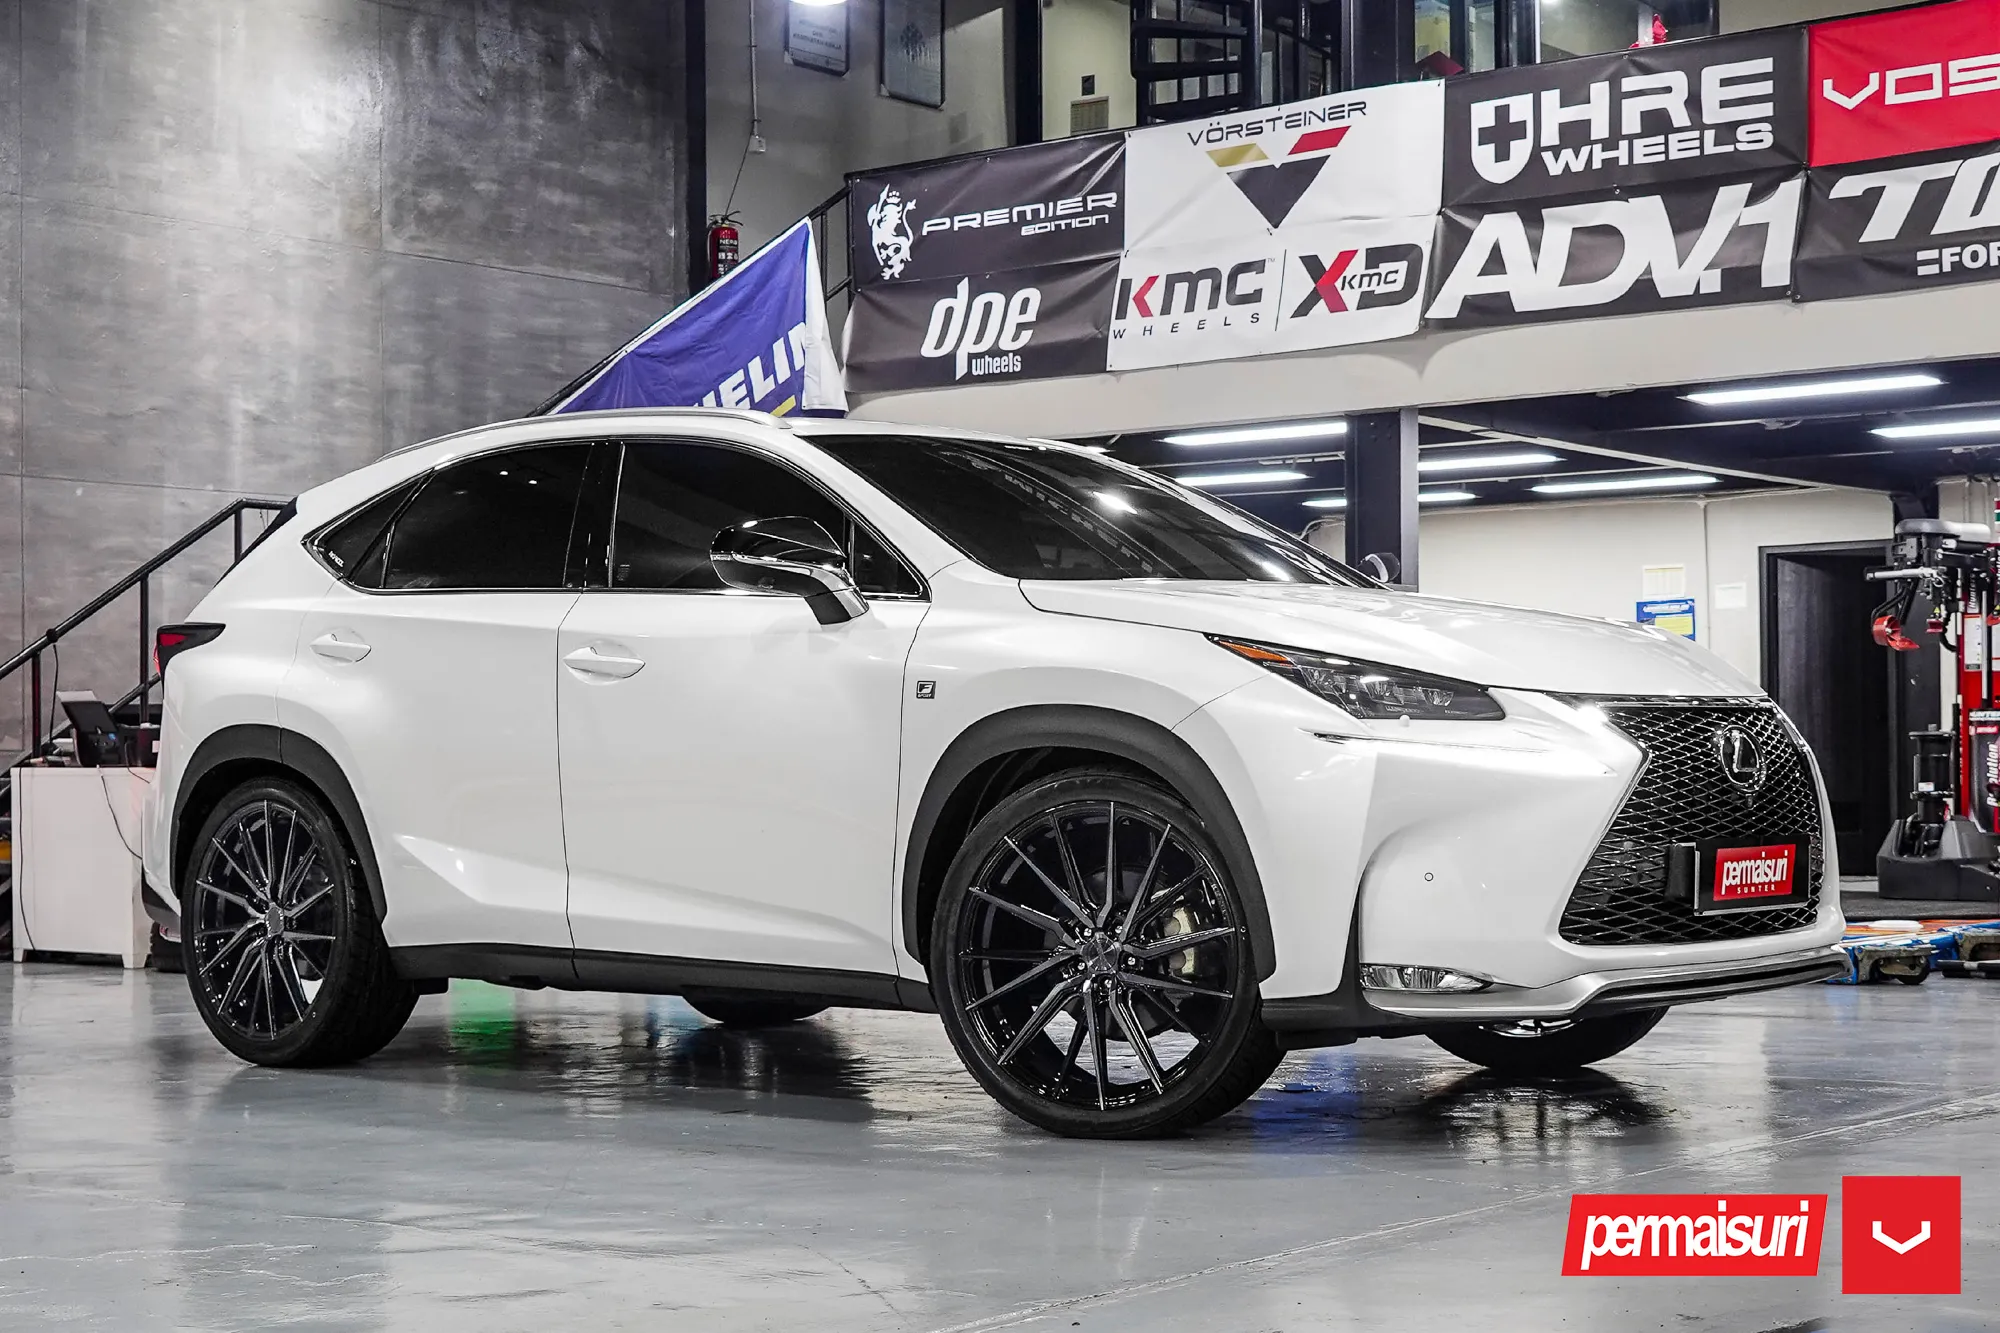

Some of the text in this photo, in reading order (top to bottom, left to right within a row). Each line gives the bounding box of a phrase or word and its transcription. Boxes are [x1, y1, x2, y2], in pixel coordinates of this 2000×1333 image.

[1187, 101, 1367, 146] VÖRSTEINER
[1540, 57, 1774, 147] HRE
[1540, 122, 1774, 176] WHEELS
[921, 192, 1118, 236] PREMIER
[1020, 214, 1109, 236] EDITION
[1424, 178, 1802, 318] ADV.1
[1290, 243, 1424, 319] XD
[920, 276, 1042, 380] dpe
[1112, 312, 1260, 340] WHEELS
[693, 322, 806, 410] ELI
[971, 352, 1022, 376] wheels
[1721, 850, 1788, 895] permaisuri
[1737, 884, 1775, 894] SUNTER
